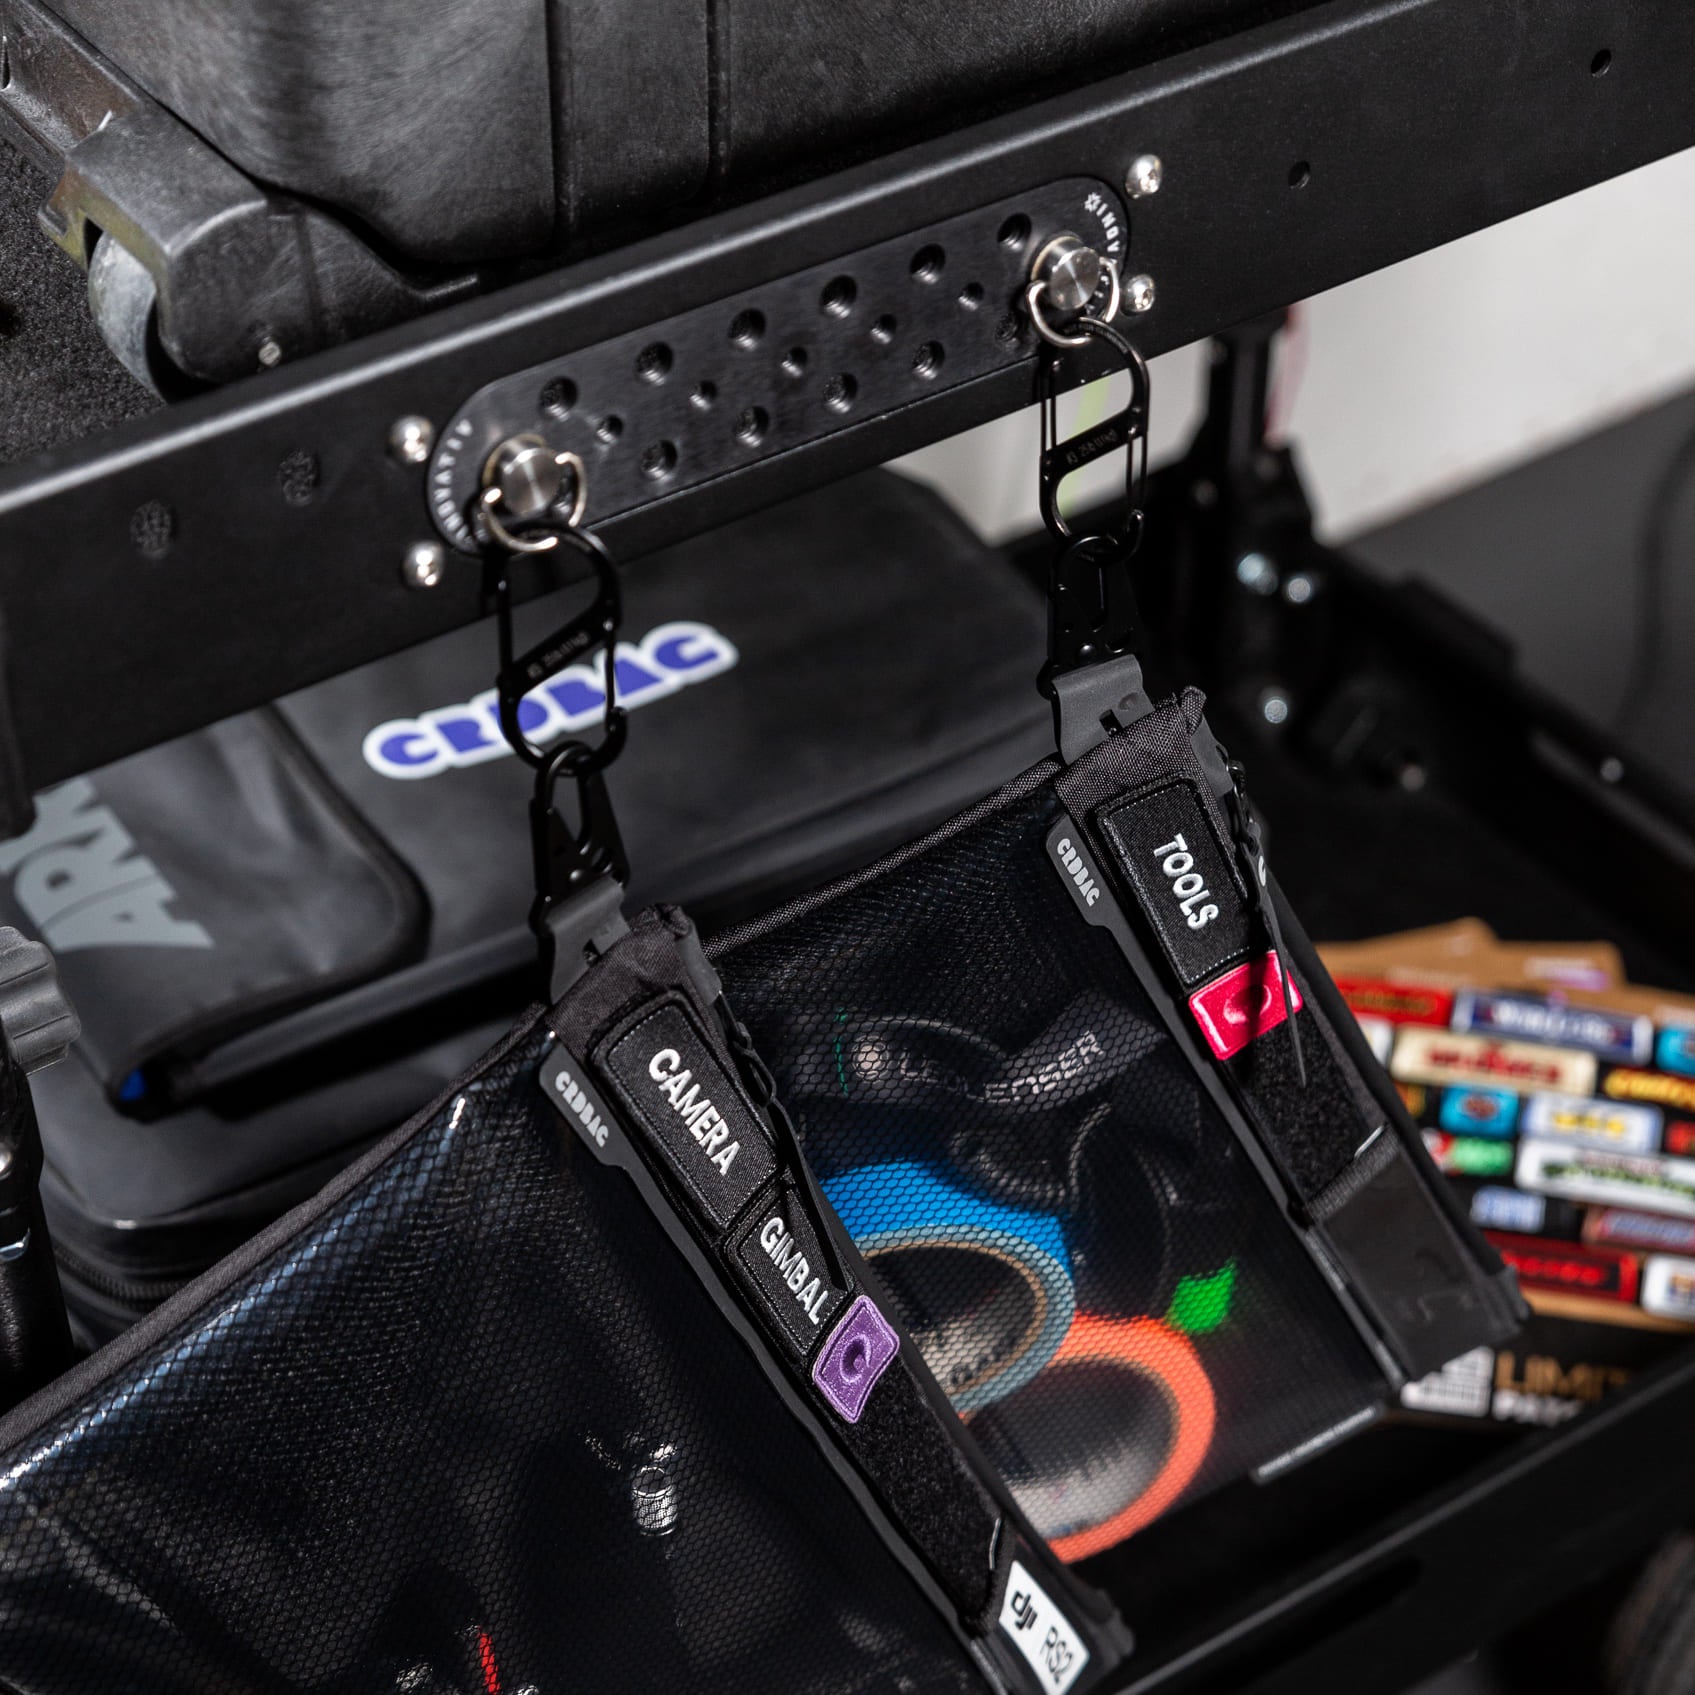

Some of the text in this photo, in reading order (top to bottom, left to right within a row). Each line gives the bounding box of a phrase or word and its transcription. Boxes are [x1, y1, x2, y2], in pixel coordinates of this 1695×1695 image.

[1153, 832, 1220, 930] TOOLS
[648, 1048, 741, 1176] CAMERA
[760, 1216, 830, 1326] GIMBAL
[1040, 1625, 1074, 1685] RS2
